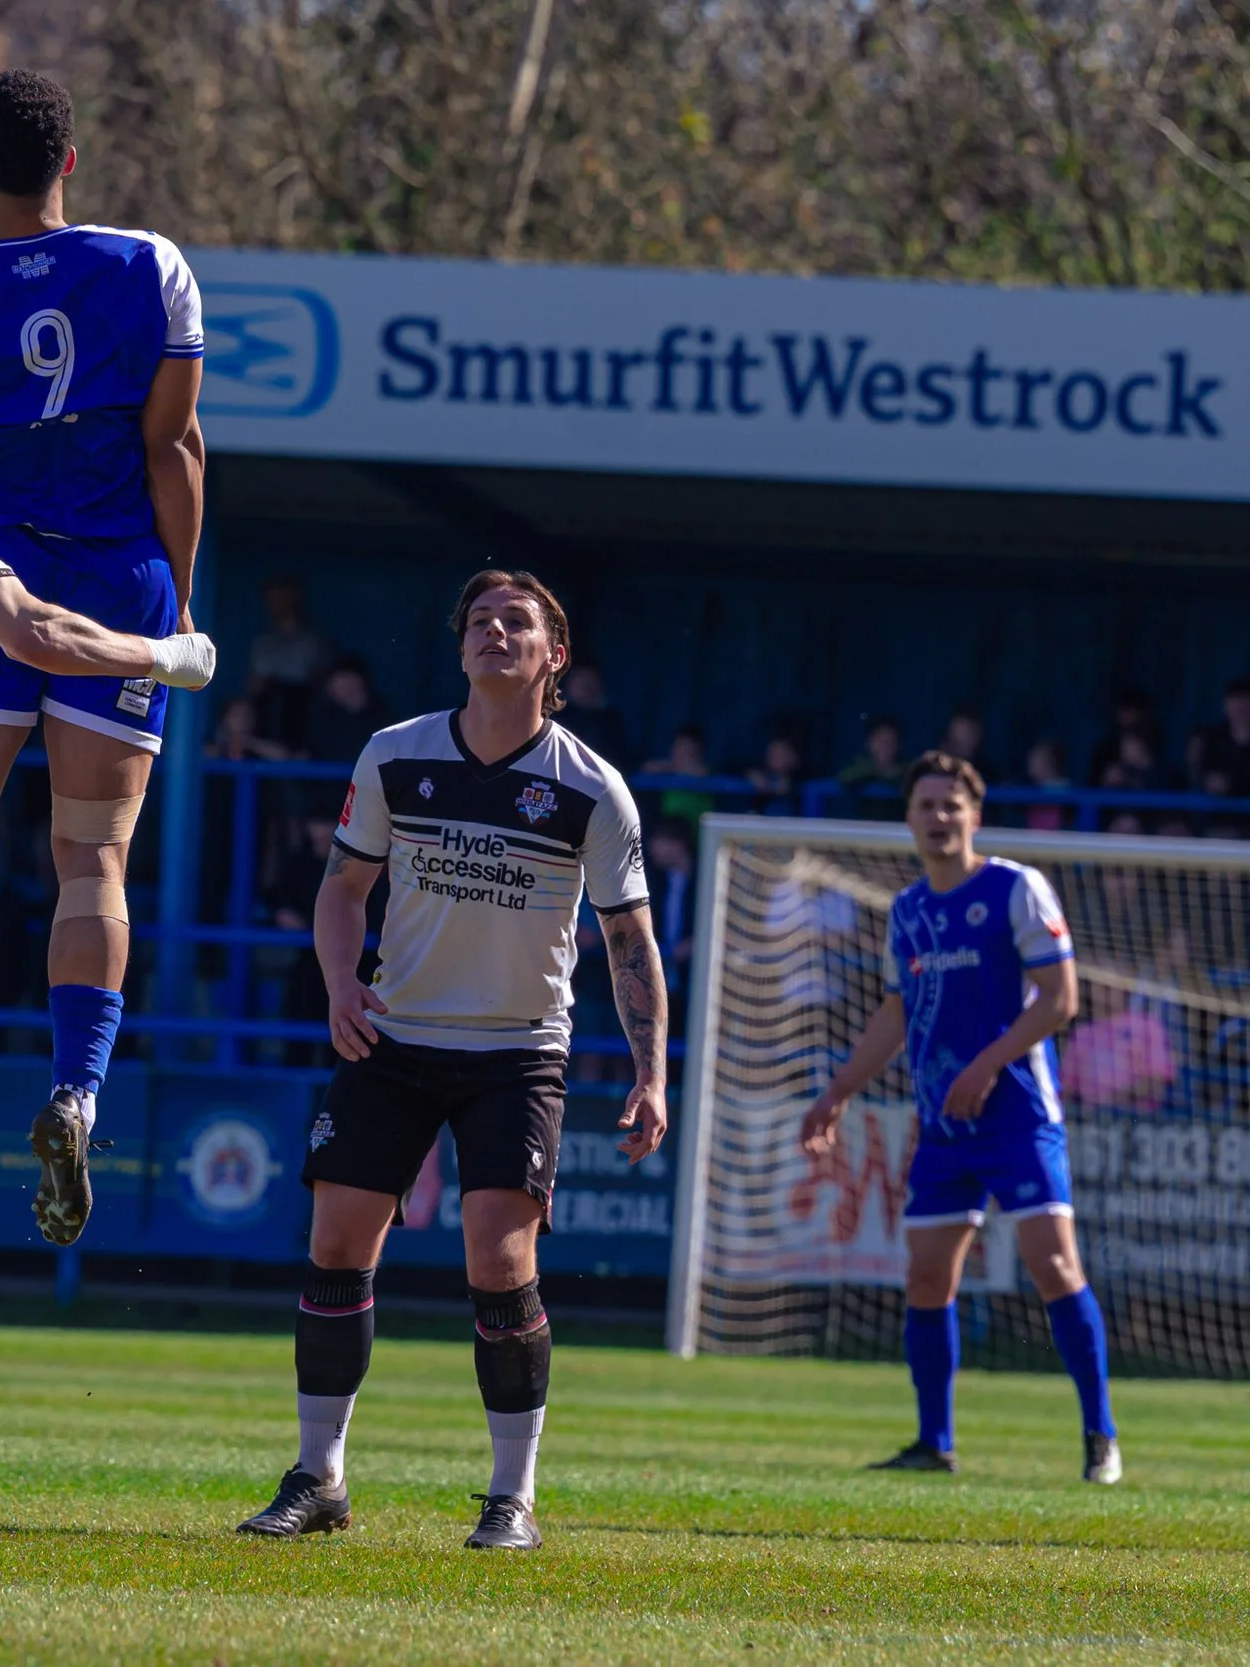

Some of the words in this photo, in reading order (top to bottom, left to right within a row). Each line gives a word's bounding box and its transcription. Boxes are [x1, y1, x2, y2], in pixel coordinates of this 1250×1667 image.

[20, 308, 75, 420] 9
[377, 315, 1224, 438] SmurfitWestrock
[442, 828, 506, 859] Hyde
[417, 875, 495, 904] Transport
[496, 889, 527, 911] Ltd
